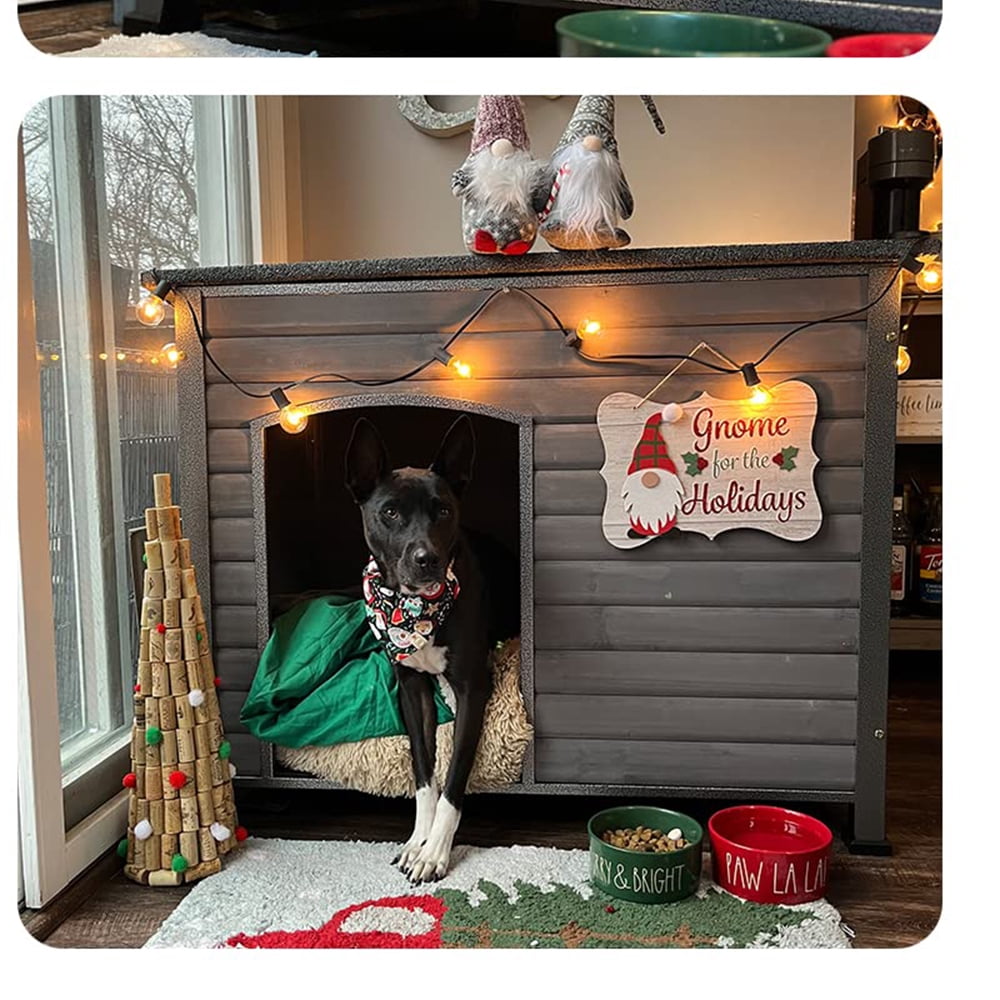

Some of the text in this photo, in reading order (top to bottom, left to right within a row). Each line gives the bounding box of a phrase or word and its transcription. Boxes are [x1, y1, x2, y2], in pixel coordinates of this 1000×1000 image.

[693, 407, 790, 452] Gnome
[712, 447, 771, 479] for the
[681, 480, 807, 523] Holidays
[613, 863, 631, 890] &
[633, 864, 685, 894] BRIGHT
[725, 852, 764, 892] PAW
[773, 862, 798, 895] LA
